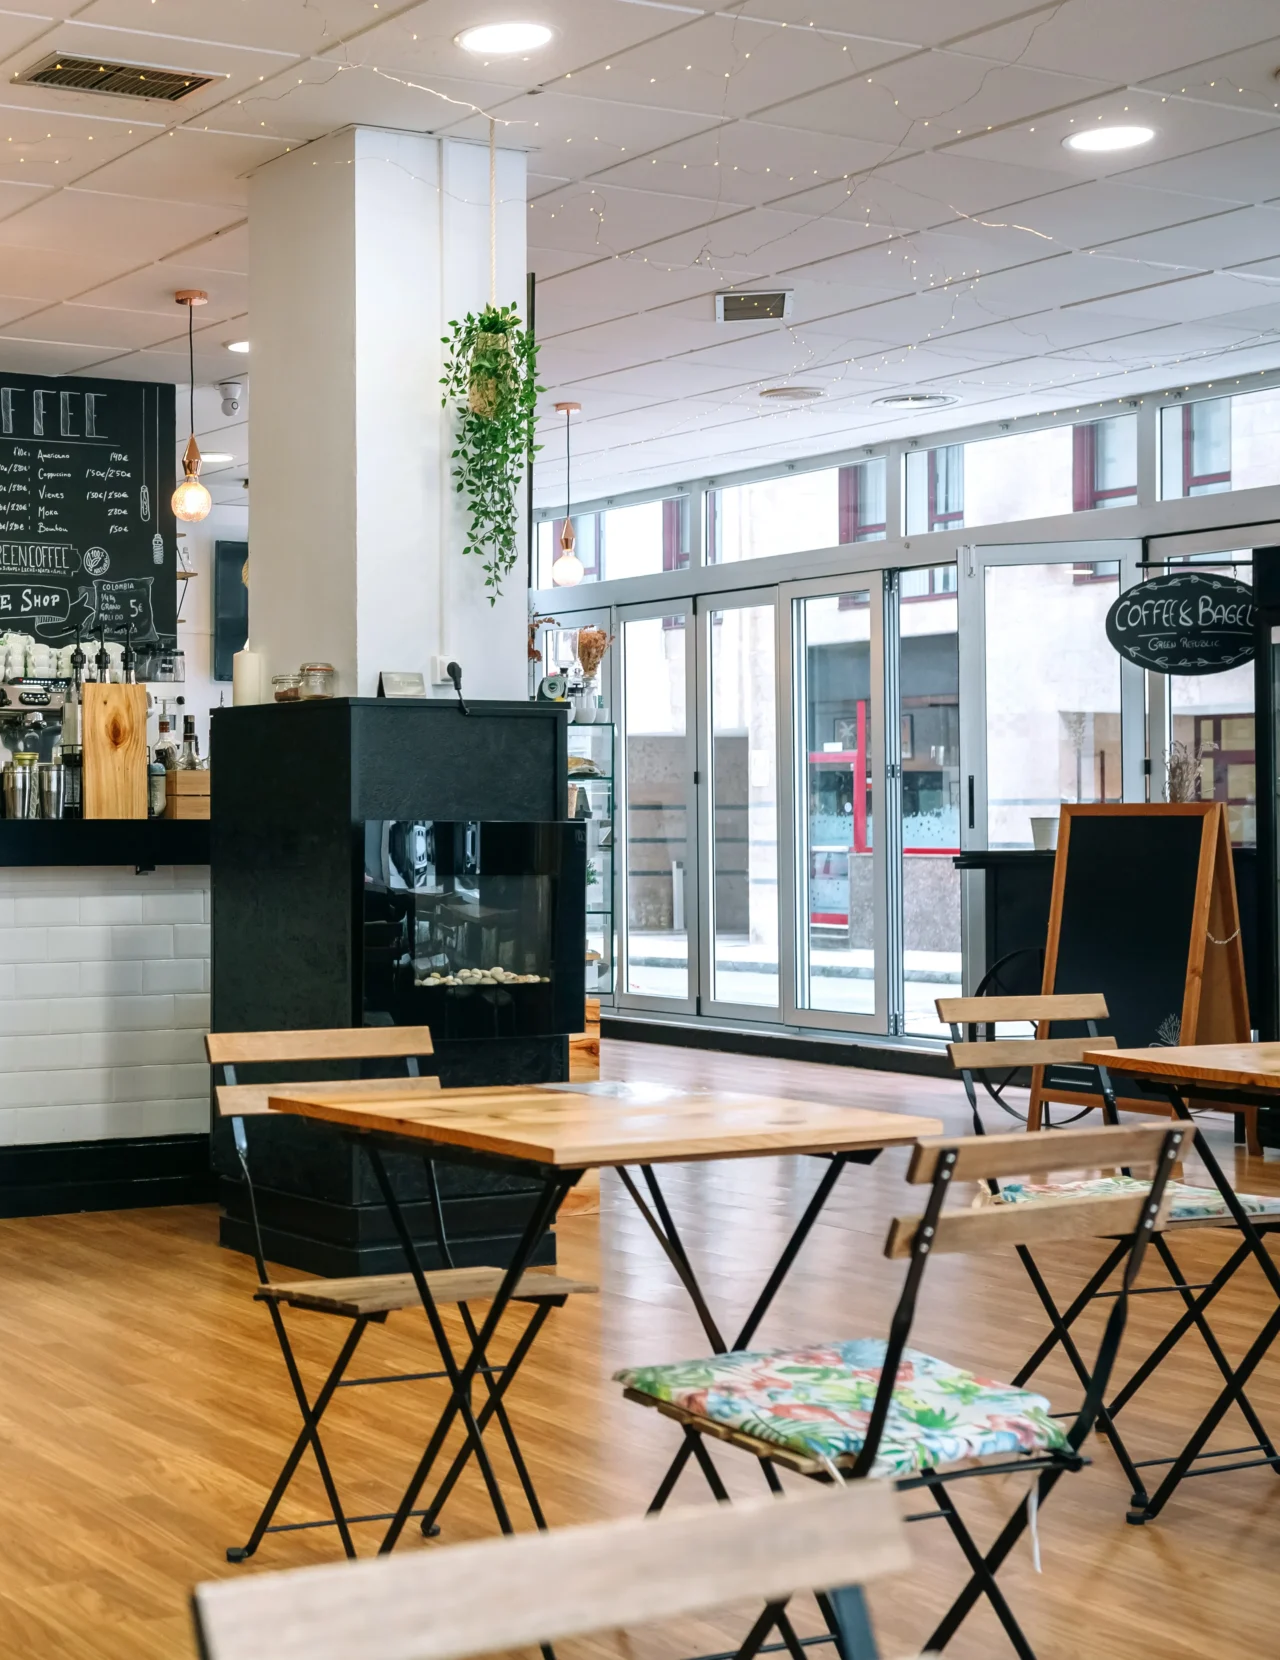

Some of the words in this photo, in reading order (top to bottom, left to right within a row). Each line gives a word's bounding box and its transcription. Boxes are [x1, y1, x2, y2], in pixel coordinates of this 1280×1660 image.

[102, 583, 134, 591] COLOMBIA
[21, 589, 60, 612] SHOP
[1115, 600, 1178, 631] COFFEE
[1198, 595, 1259, 627] BAGEL
[1148, 637, 1176, 651] GREEN
